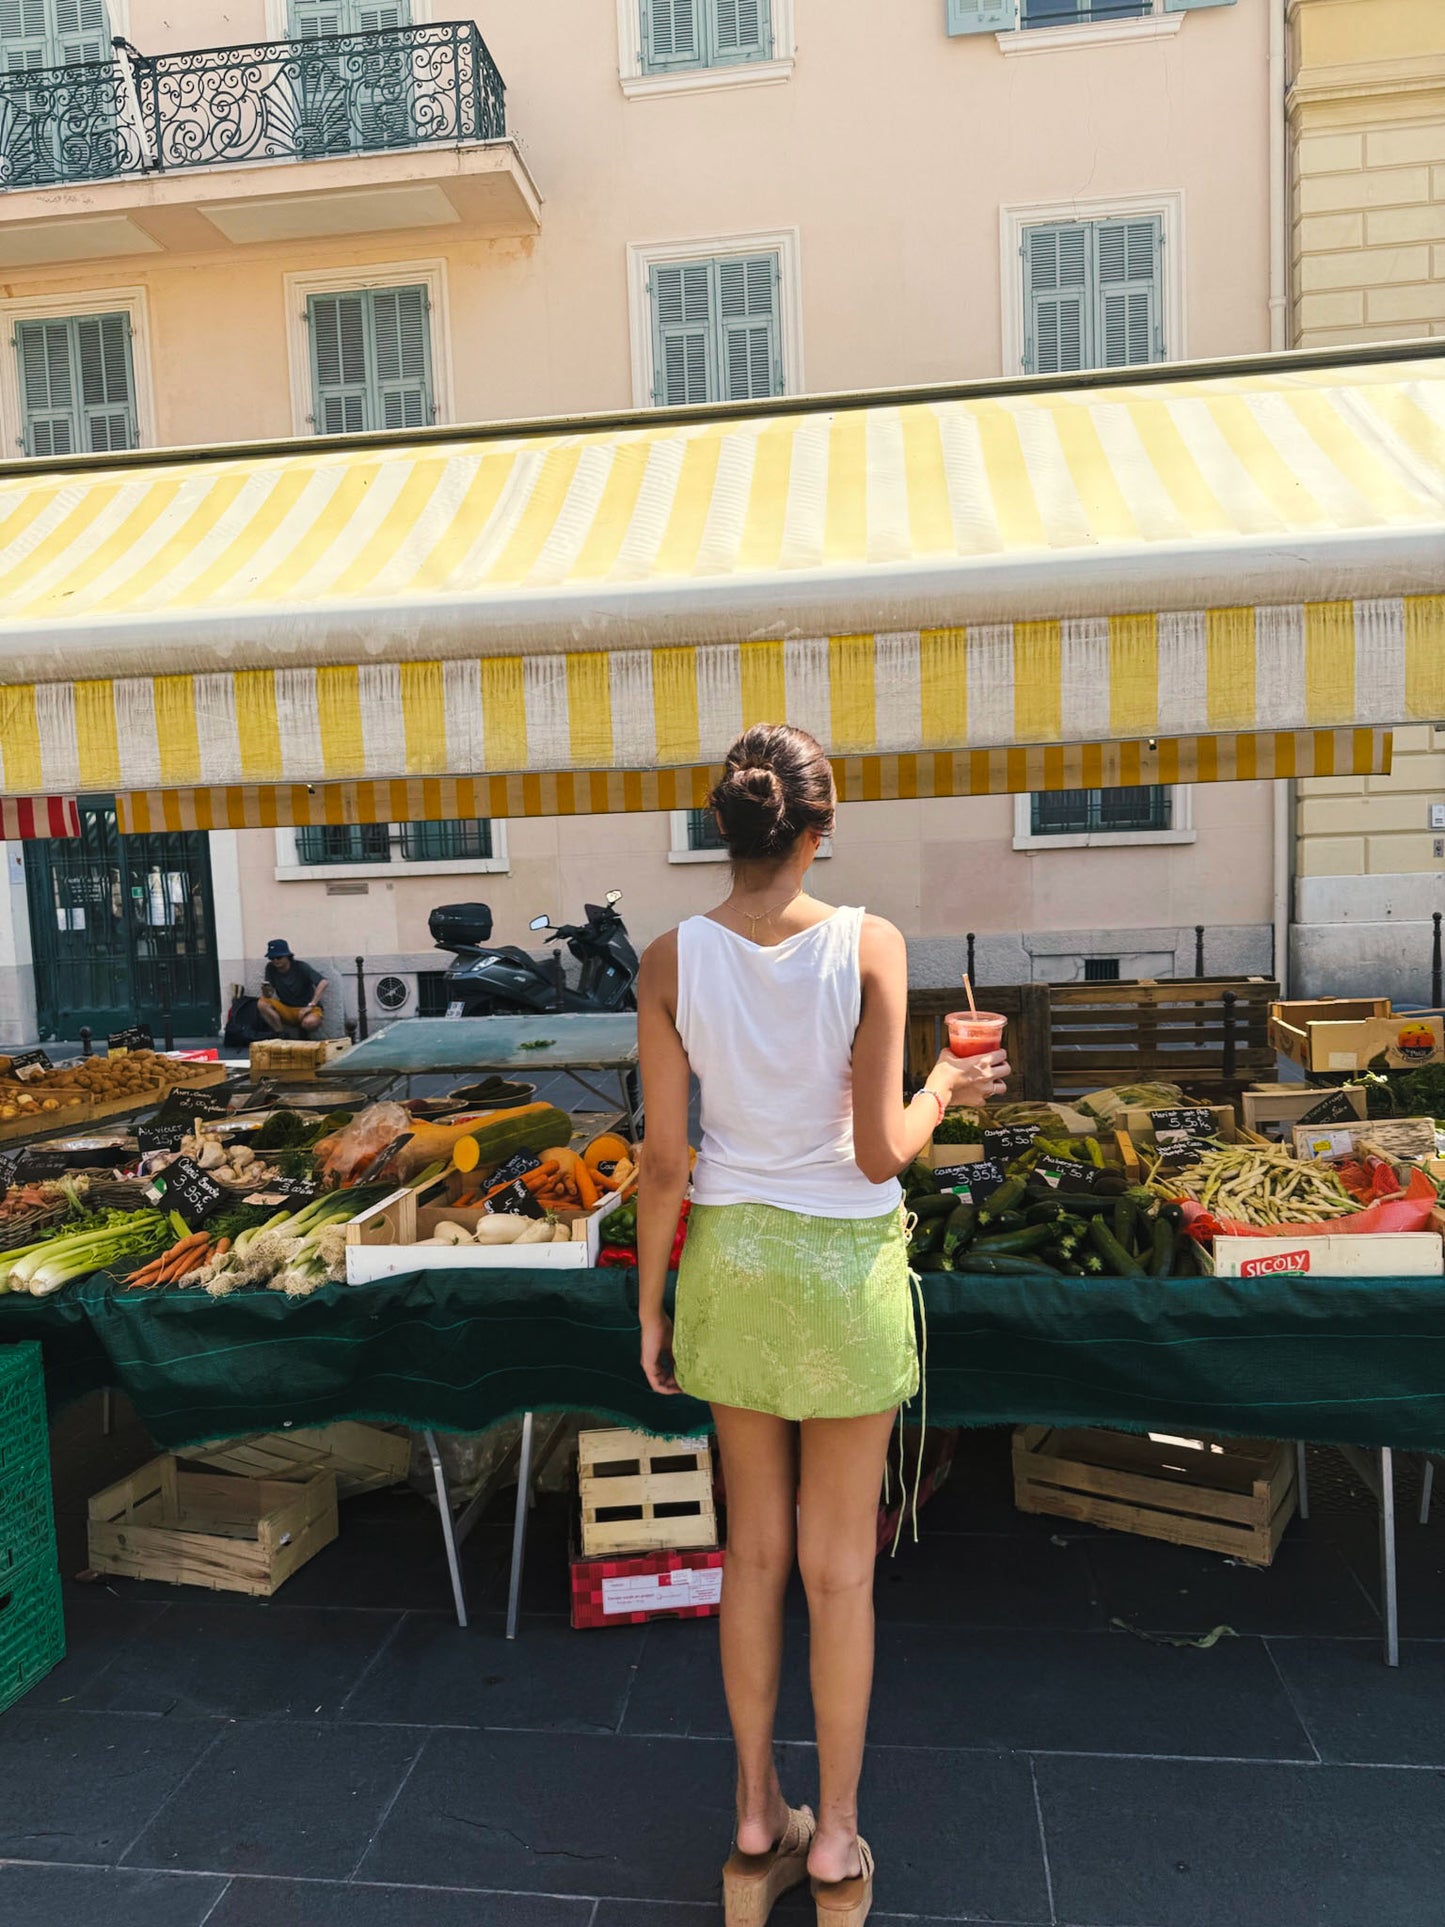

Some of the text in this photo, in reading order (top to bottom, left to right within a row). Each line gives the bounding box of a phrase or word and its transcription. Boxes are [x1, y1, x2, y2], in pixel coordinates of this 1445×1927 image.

[1168, 1117, 1198, 1129] 5,50
[956, 1170, 991, 1186] 3,95
[172, 1174, 203, 1204] 3,95
[1246, 1253, 1306, 1277] SICOLY
